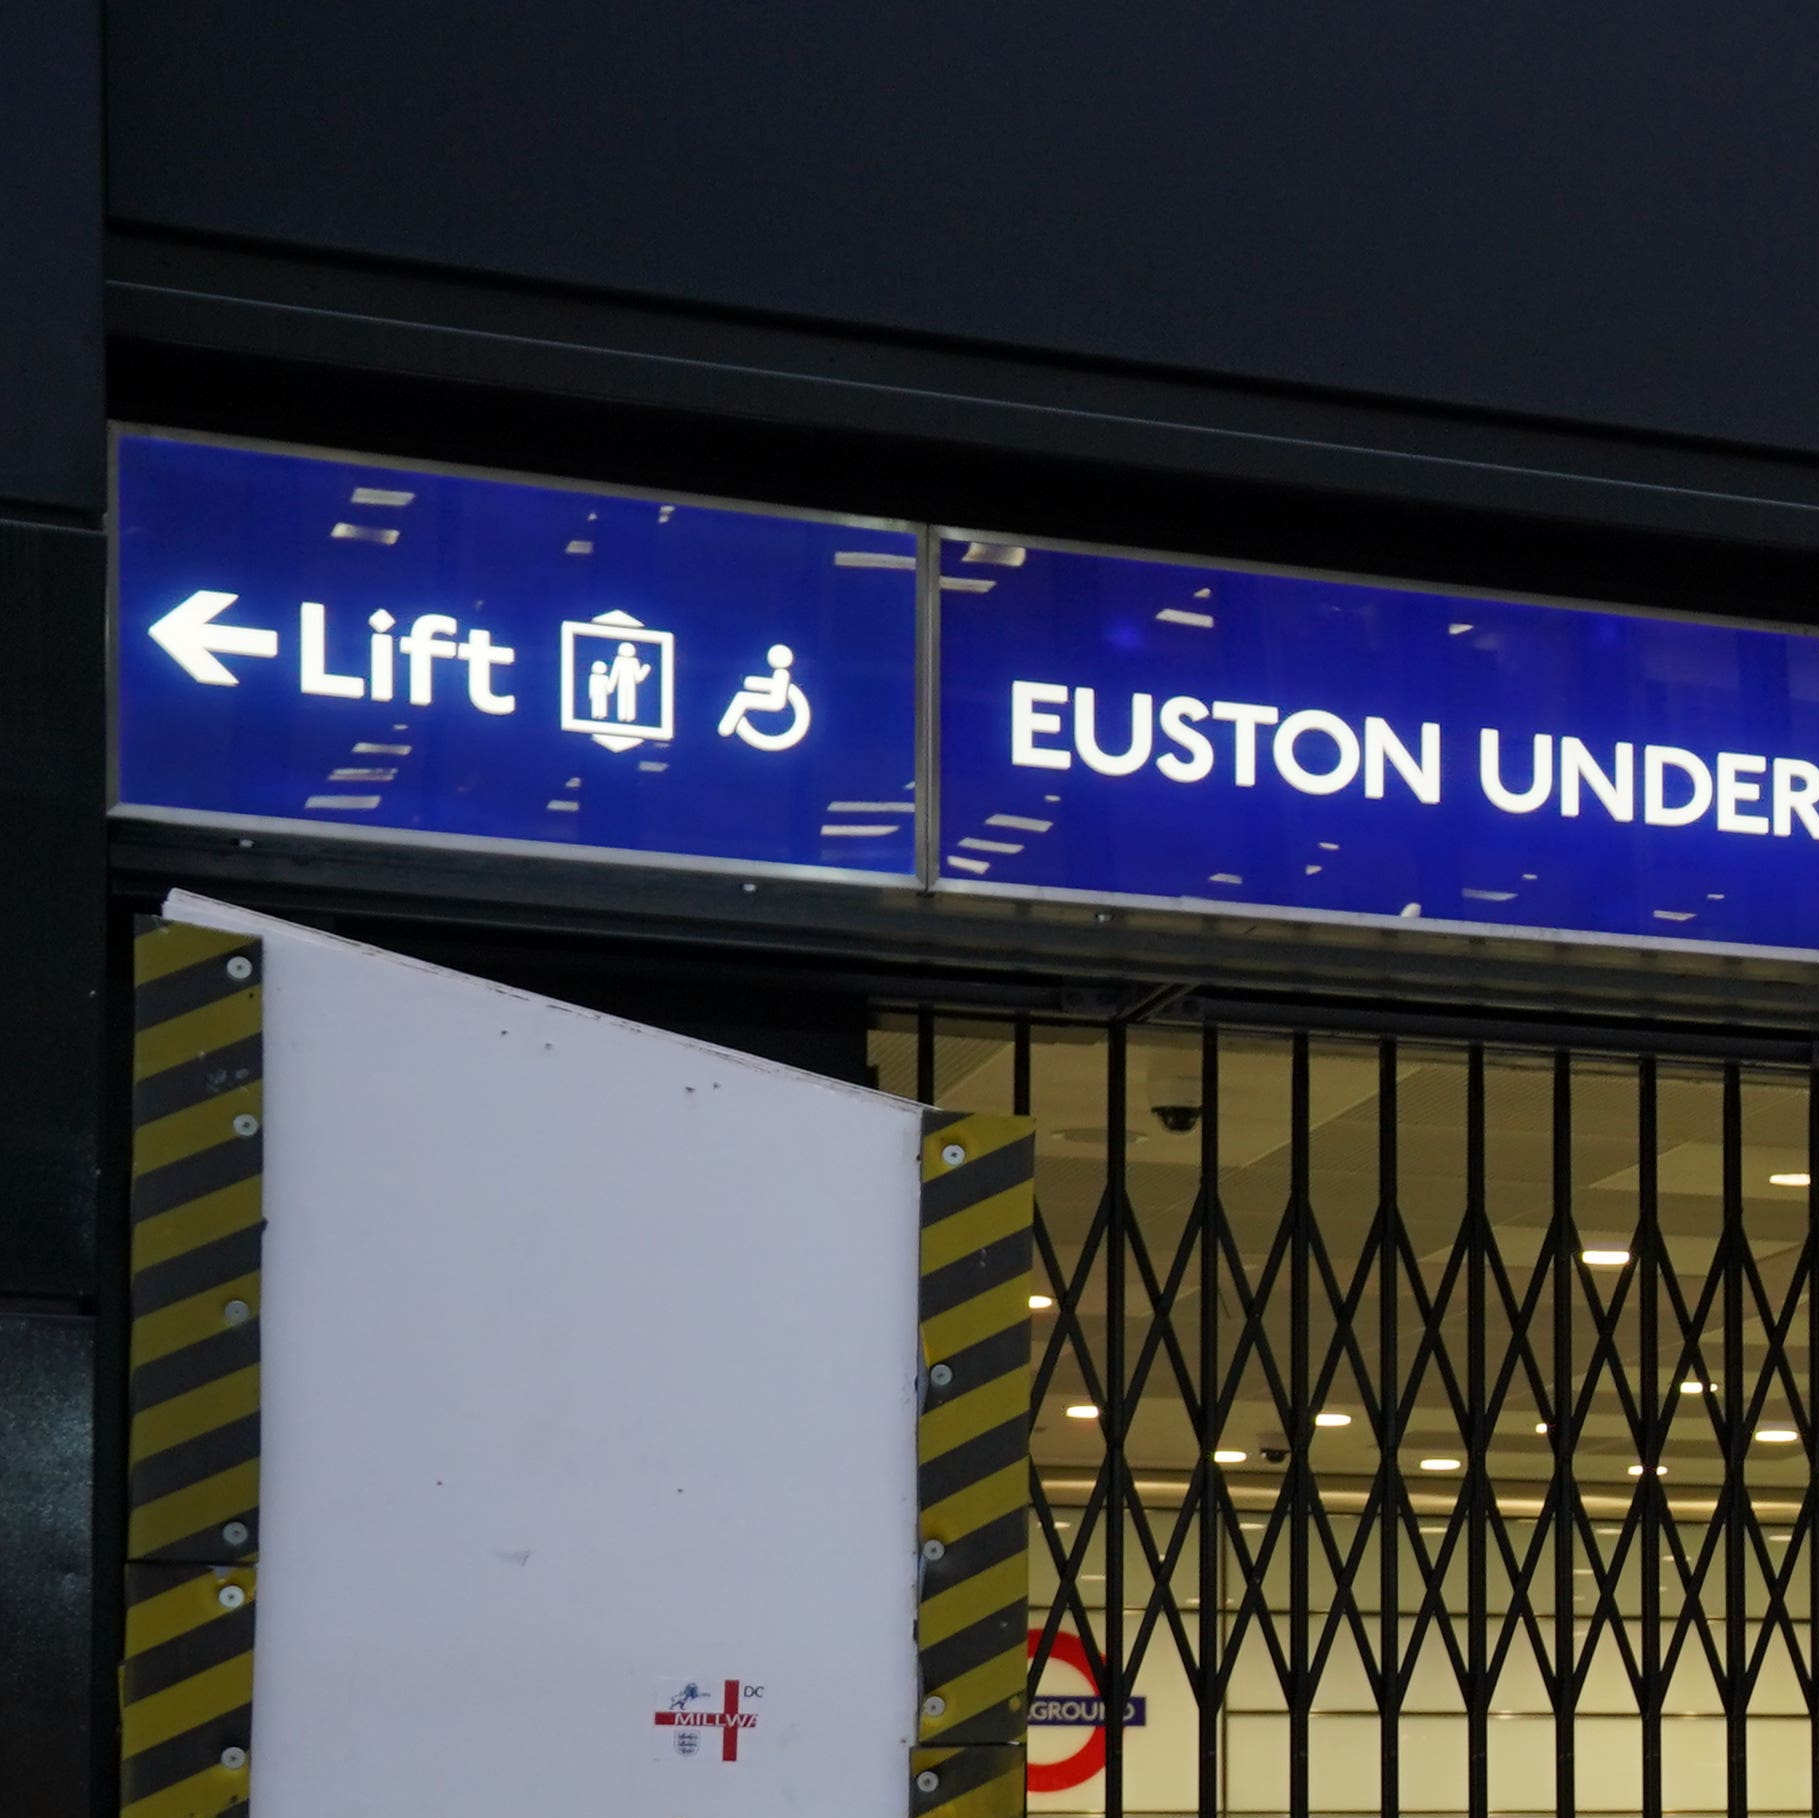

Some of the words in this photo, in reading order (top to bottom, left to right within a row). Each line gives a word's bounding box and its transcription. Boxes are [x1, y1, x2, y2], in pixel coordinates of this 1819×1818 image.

[300, 602, 516, 715] Lift
[1011, 680, 1441, 804] EUSTON
[743, 1685, 765, 1698] DC
